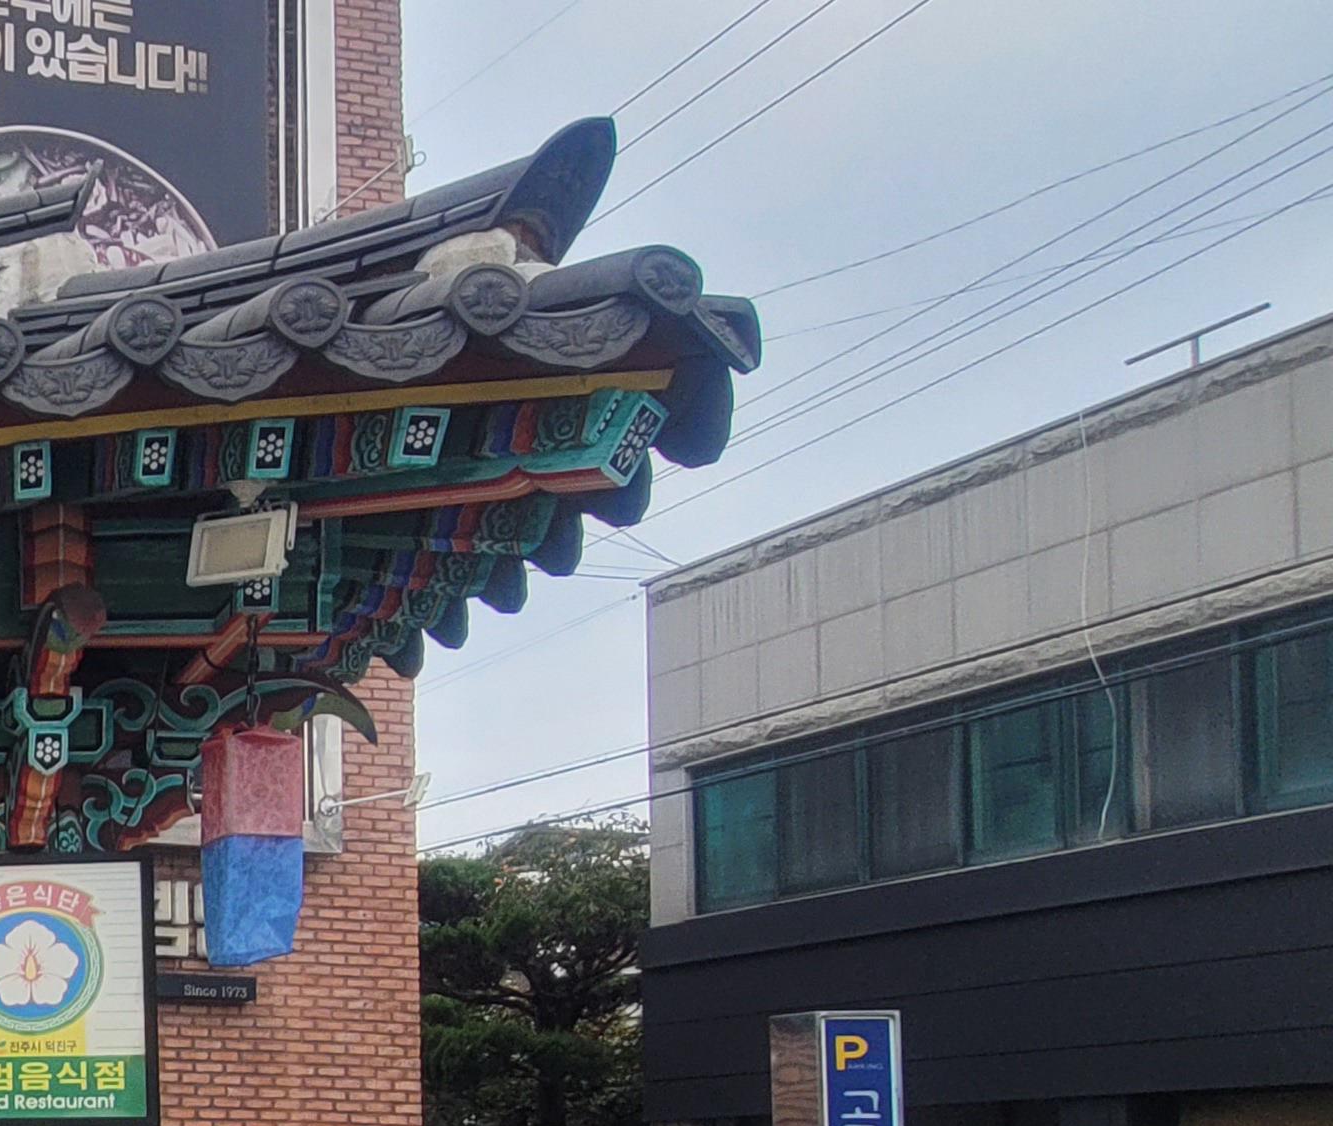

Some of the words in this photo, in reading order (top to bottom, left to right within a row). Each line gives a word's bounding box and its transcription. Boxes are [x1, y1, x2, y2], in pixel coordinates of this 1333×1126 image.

[25, 28, 208, 94] 있습니다!!
[184, 984, 217, 998] Since
[221, 986, 248, 999] 1973
[10, 1040, 41, 1054] 전주시
[45, 1039, 78, 1053] 덕진구
[14, 1093, 115, 1109] Restaurant
